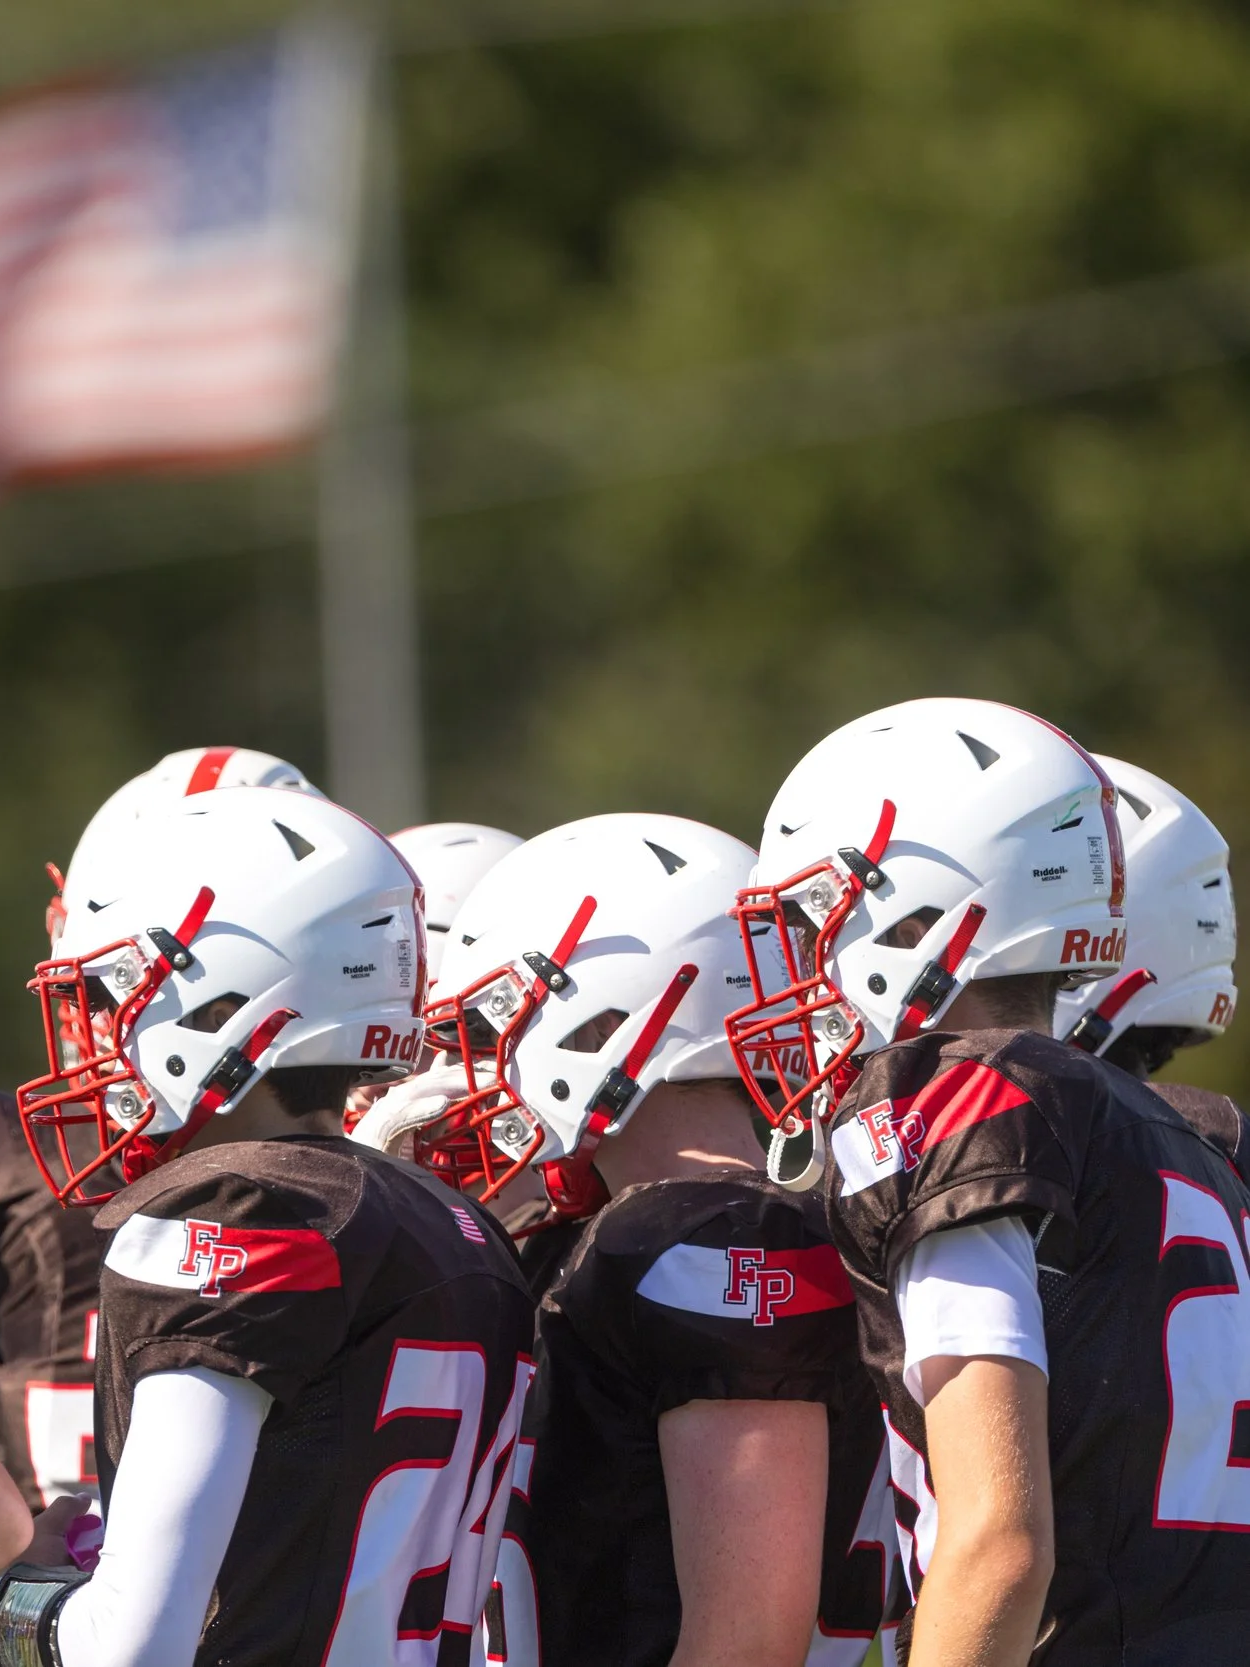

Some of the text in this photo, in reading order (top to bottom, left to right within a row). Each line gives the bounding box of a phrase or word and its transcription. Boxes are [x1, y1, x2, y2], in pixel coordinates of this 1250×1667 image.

[1033, 866, 1065, 877] Riddell
[1060, 928, 1126, 964] Ridd
[343, 964, 374, 974] Riddell
[726, 975, 751, 984] Ridde
[856, 1098, 925, 1174] FP
[177, 1218, 248, 1298] FP
[723, 1246, 794, 1326] FP
